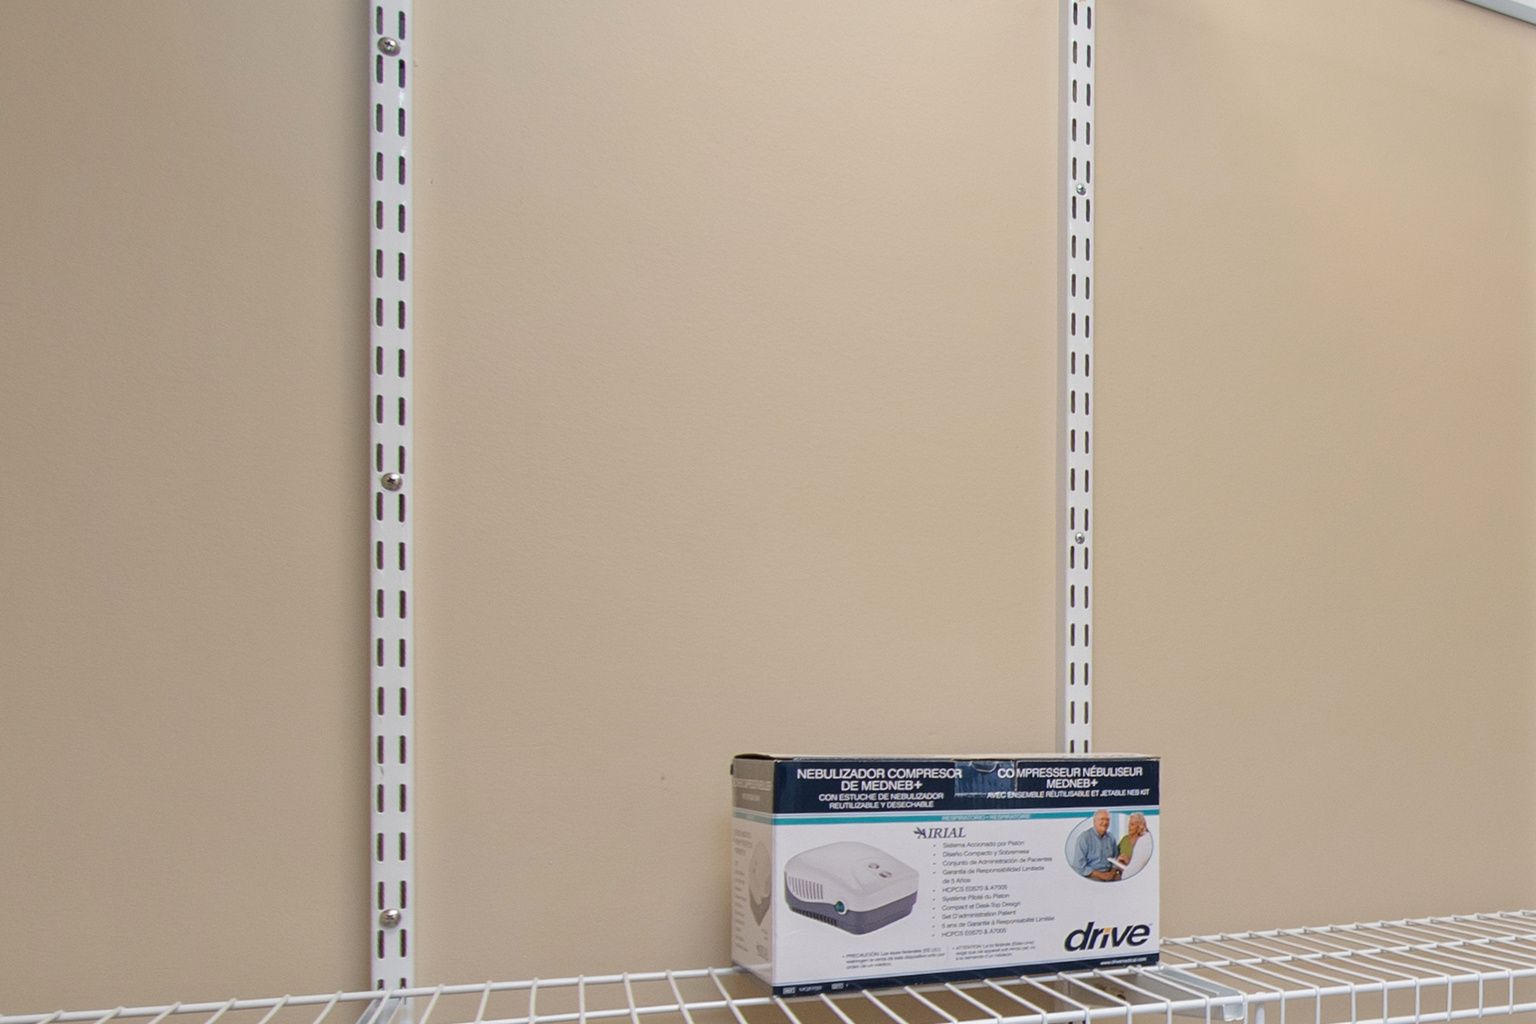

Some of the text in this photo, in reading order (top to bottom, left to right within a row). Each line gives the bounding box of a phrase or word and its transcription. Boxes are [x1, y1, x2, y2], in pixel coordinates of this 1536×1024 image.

[797, 768, 963, 780] NEBULIZADOR COMPRESOR
[997, 765, 1143, 778] COMPRESSEUR NÉBULISEUR
[841, 780, 923, 791] DE MEDNEB+
[1046, 779, 1099, 789] MEDNEB+
[890, 792, 945, 800] NEBULIZADOR
[987, 791, 1006, 799] AVEC
[1007, 790, 1044, 798] ENSEMBLE
[1045, 789, 1090, 798] RÉUTILISABLE
[1091, 789, 1100, 797] ET
[1100, 788, 1126, 797] JETABLE
[829, 801, 880, 809] REUTILIZABLE
[886, 800, 934, 808] DESECHABLE
[1064, 921, 1150, 951] drive
